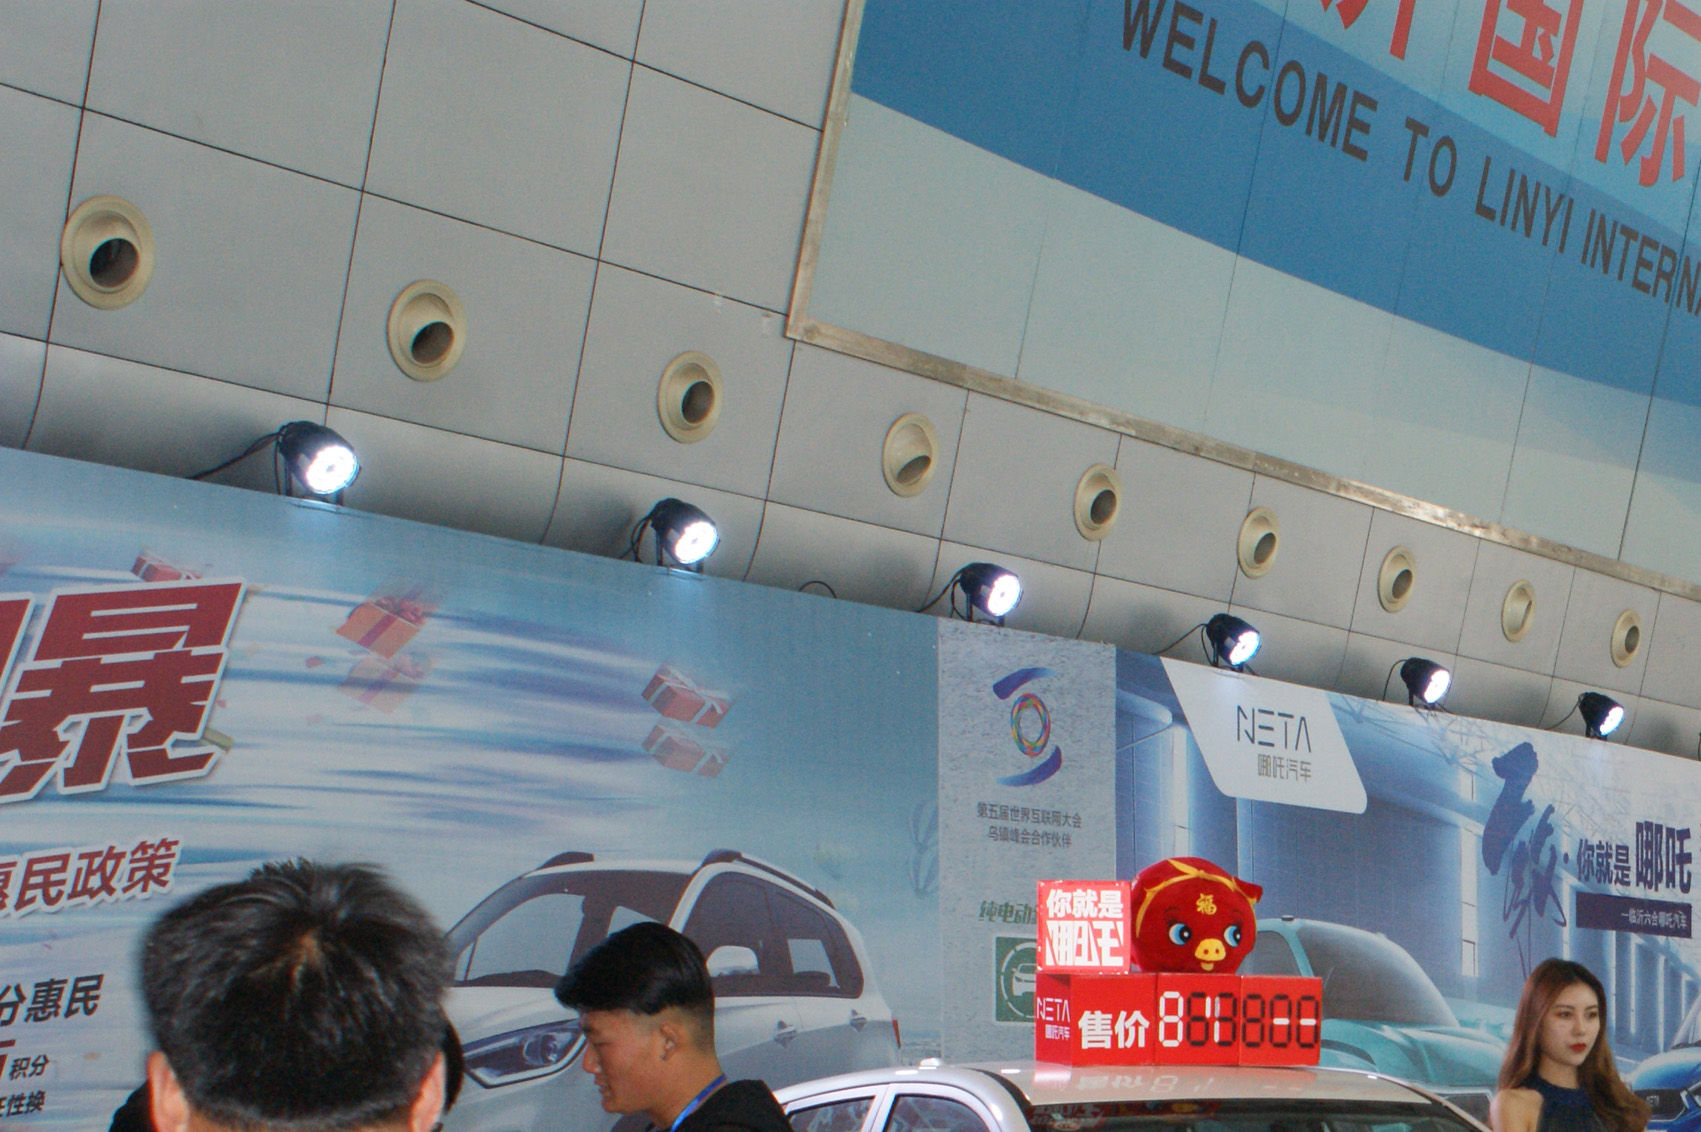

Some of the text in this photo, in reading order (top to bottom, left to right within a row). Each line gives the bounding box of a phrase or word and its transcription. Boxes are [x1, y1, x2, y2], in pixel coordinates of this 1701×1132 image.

[1119, 0, 1379, 162] WELCOME
[1402, 115, 1459, 198] TO
[1474, 156, 1577, 256] LINYI
[1237, 704, 1312, 754] NETA
[1257, 753, 1313, 783] 哪吒汽车
[976, 801, 1083, 829] 第五届世界互联网大会
[987, 825, 1072, 848] 乌镇峰会合作伙伴
[978, 900, 1036, 925] 纯电动
[1046, 888, 1124, 919] 你就是
[1196, 893, 1218, 916] 福
[1037, 997, 1071, 1024] NETA
[1078, 1010, 1150, 1050] 售价
[9, 1053, 50, 1081] 积分
